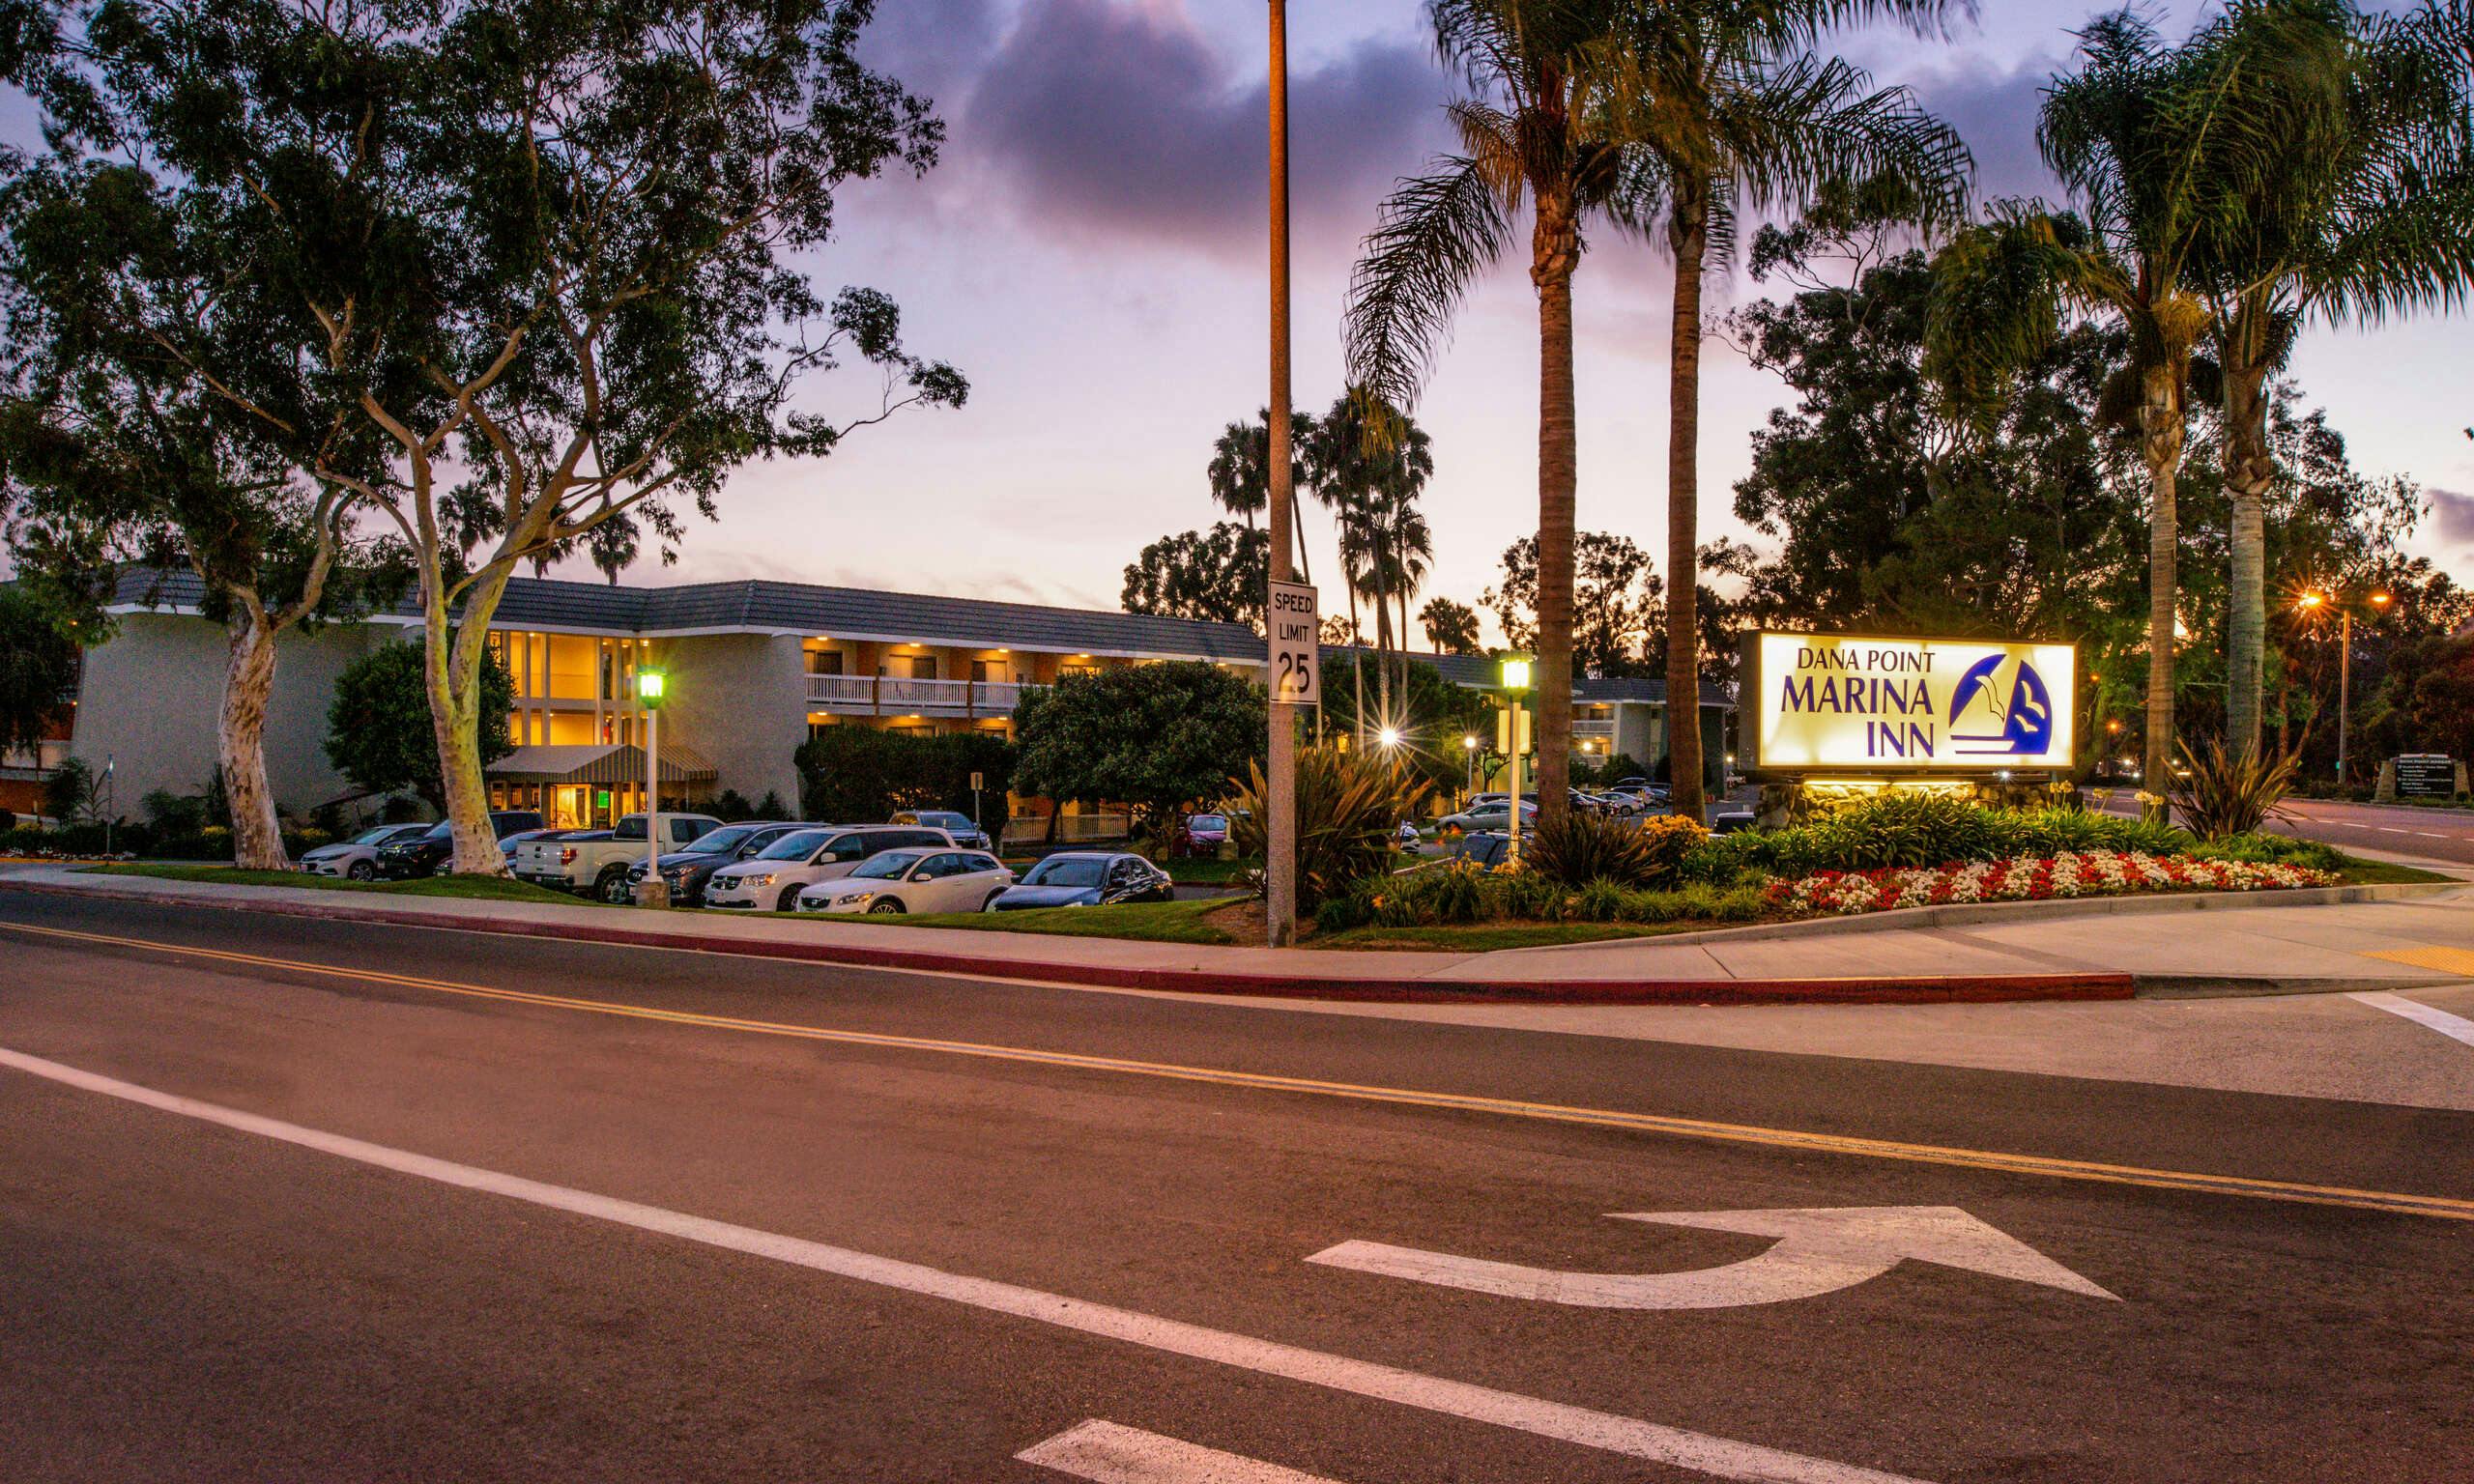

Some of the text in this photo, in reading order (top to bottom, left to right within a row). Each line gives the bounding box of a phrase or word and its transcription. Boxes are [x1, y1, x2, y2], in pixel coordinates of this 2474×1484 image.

[1275, 592, 1313, 614] SPEED
[1279, 622, 1309, 642] LIMIT
[1278, 651, 1310, 694] 25
[1798, 647, 1936, 672] DANA POINT
[1781, 674, 1935, 715] MARINA
[1866, 721, 1935, 758] INN
